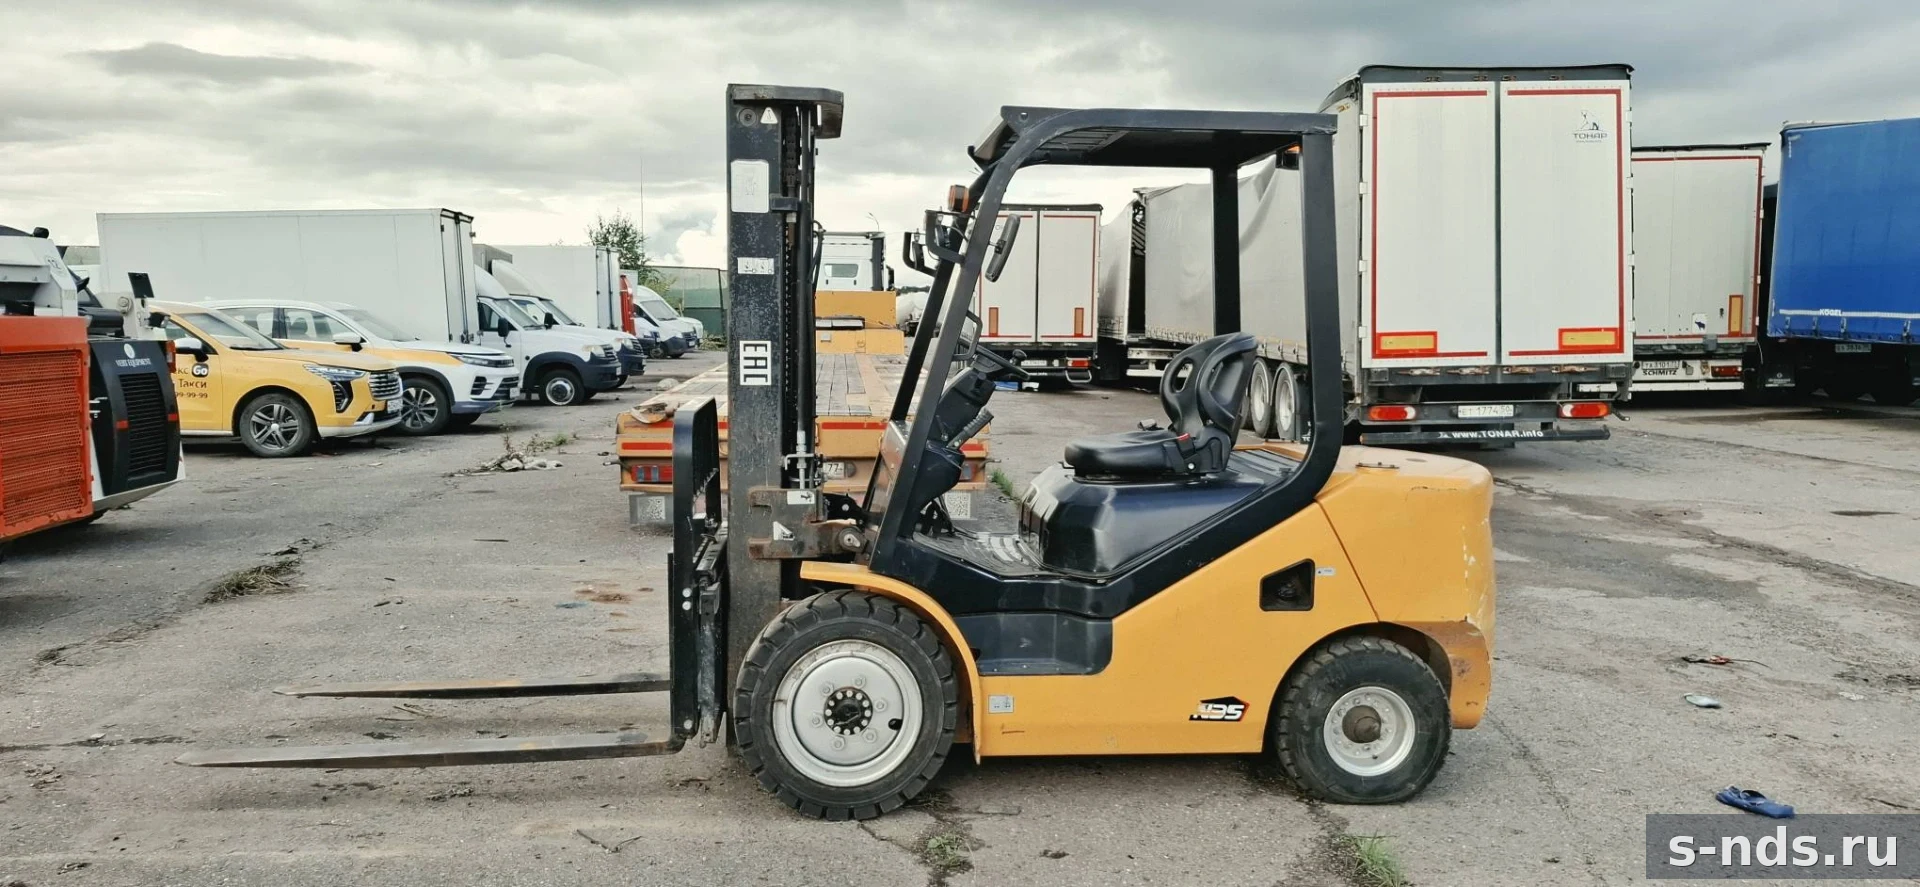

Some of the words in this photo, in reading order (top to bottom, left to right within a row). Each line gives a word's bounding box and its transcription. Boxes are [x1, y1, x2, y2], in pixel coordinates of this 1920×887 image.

[743, 343, 768, 383] EAC
[179, 379, 207, 389] Такси
[1452, 430, 1544, 438] www.TONAR.info
